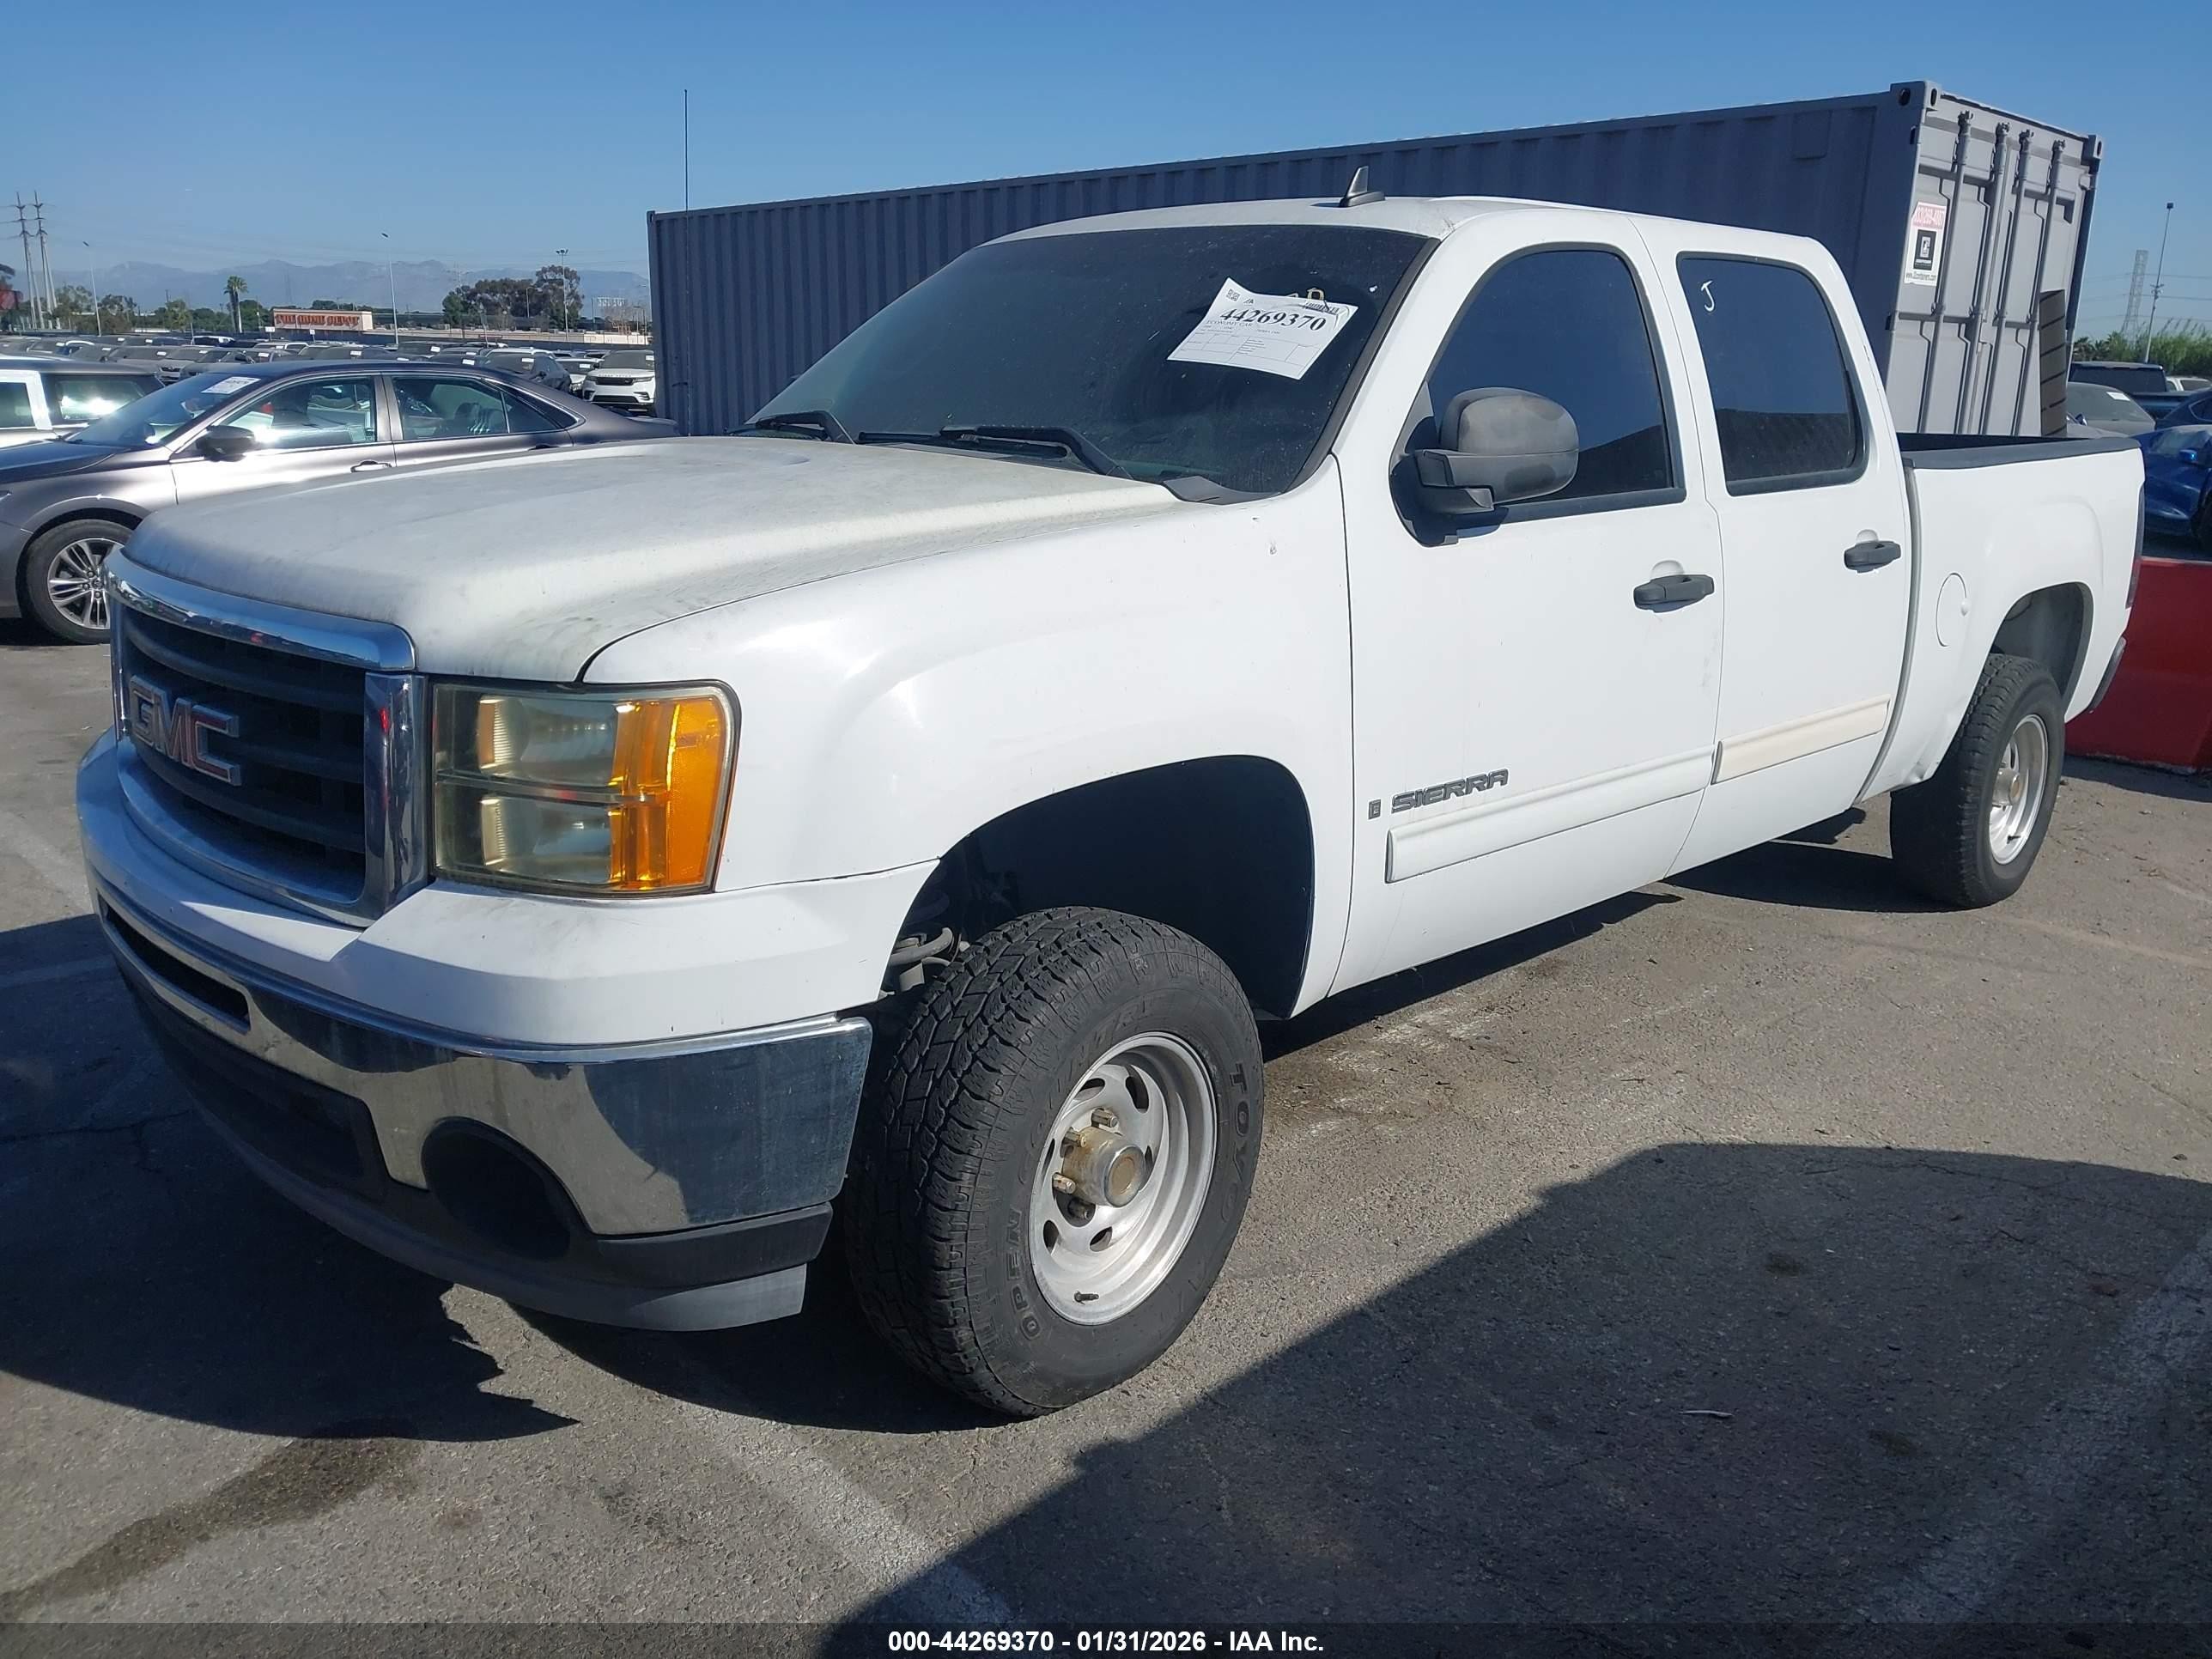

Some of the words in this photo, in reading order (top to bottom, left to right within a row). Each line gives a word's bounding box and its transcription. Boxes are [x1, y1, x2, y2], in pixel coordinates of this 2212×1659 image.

[1219, 307, 1328, 331] 44269370
[1701, 280, 1715, 313] J
[129, 674, 242, 787] GMC
[1390, 768, 1510, 814] SIERRA
[1219, 1061, 1250, 1223] TOYO
[1004, 1209, 1042, 1340] OPEN
